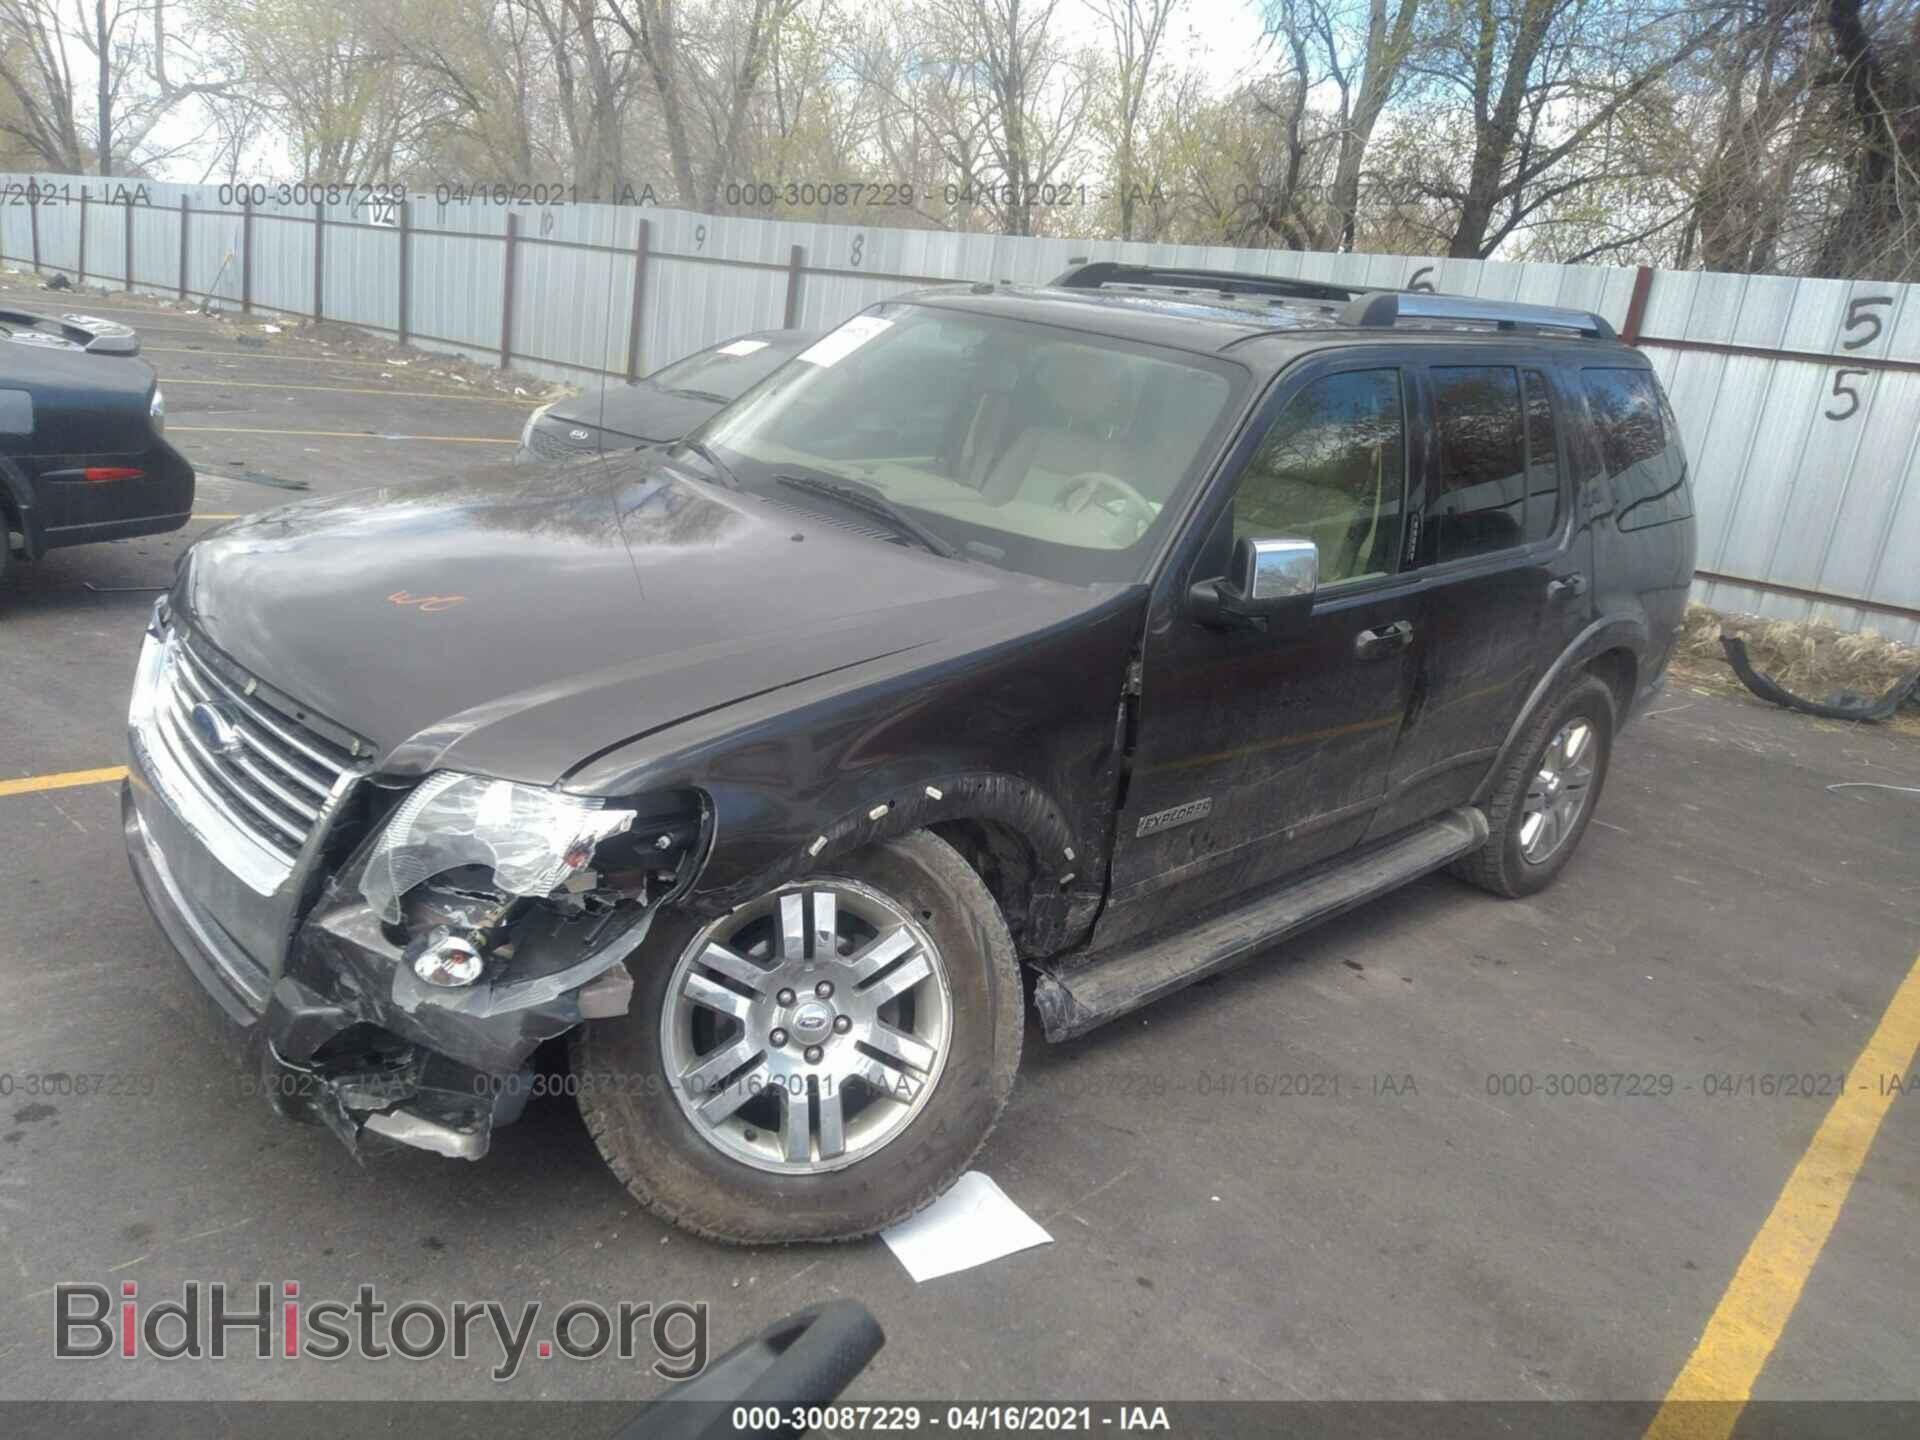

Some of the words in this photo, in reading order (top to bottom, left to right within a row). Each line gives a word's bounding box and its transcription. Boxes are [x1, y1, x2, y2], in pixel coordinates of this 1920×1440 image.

[695, 224, 706, 251] 9
[851, 234, 865, 267] 8
[1843, 297, 1894, 350] 5
[1825, 369, 1869, 421] 5
